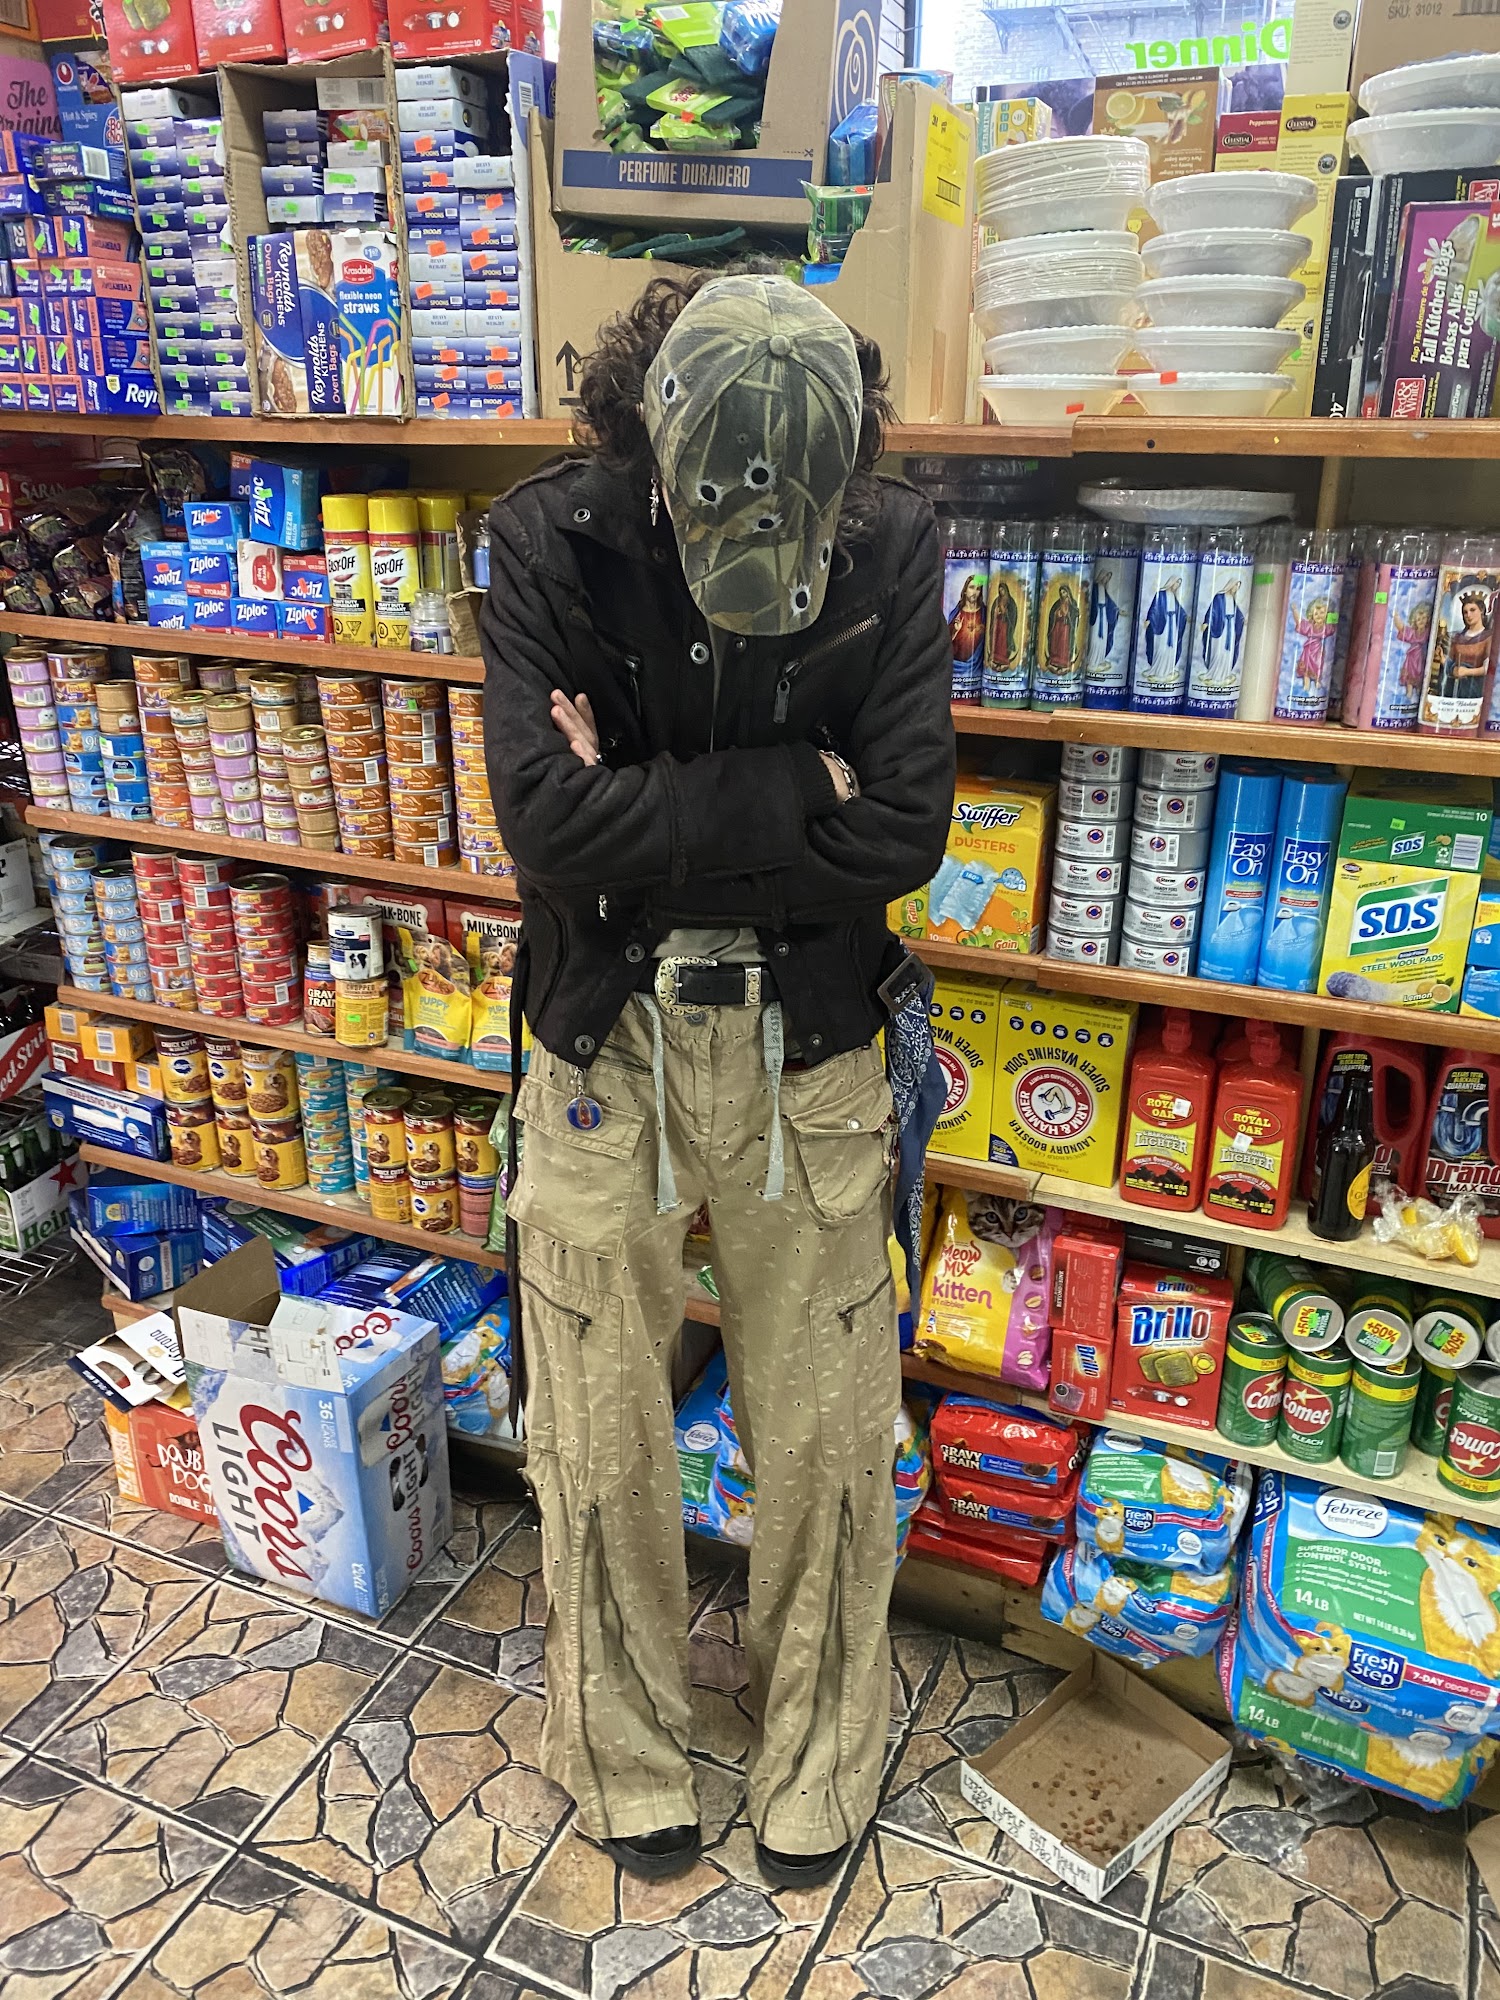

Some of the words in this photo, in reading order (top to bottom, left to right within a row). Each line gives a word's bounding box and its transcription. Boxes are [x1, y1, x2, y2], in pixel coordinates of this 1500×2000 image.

[474, 39, 481, 47] 10
[7, 80, 48, 110] The
[619, 159, 677, 185] PERFUME
[681, 162, 750, 188] DURADERO
[264, 243, 272, 274] Oven
[344, 263, 372, 275] Krasdale
[1433, 239, 1455, 277] Bags
[278, 241, 296, 313] Reynolds
[265, 277, 274, 304] Bags
[274, 271, 285, 325] KITCHENS
[340, 291, 363, 300] flexible
[1446, 283, 1465, 319] Altas
[343, 302, 380, 314] straws
[1426, 280, 1447, 335] Kitchen
[1461, 289, 1479, 335] Cocina
[317, 322, 329, 377] KITCHENS
[1411, 345, 1420, 362] Flap
[1421, 339, 1437, 364] Tall
[1441, 322, 1459, 366] Bolsas
[1457, 338, 1472, 368] para
[329, 344, 339, 370] Bags
[307, 335, 325, 404] Reynolds
[125, 384, 159, 407] Reyn
[330, 374, 340, 403] Oven
[292, 474, 299, 485] 28
[252, 476, 271, 528] Ziploc
[189, 557, 220, 574] Ziploc
[328, 556, 355, 573] EASY-OFF
[374, 558, 404, 576] EASY-OFF
[153, 569, 182, 585] Ziploc
[194, 601, 225, 618] Ziploc
[236, 604, 268, 620] Ziploc
[952, 803, 1019, 829] Swiffer
[1476, 812, 1487, 821] 10
[954, 836, 1016, 854] DUSTERS
[1229, 838, 1270, 862] Easy
[1232, 858, 1262, 876] On
[1284, 844, 1328, 871] Easy
[1286, 865, 1318, 885] On
[907, 901, 918, 924] Gain
[929, 933, 939, 941] 10
[994, 939, 1018, 950] Gain
[1361, 963, 1388, 973] STEEL
[1390, 959, 1418, 968] WOOL
[1419, 954, 1444, 963] PADS
[419, 996, 449, 1010] PUPPY
[1403, 992, 1433, 1002] Lemon
[957, 1036, 984, 1068] SUPER
[1028, 1046, 1078, 1068] WASHING
[1003, 1052, 1026, 1075] SODA
[1080, 1059, 1110, 1093] SUPER
[1020, 1090, 1059, 1136] HAMMER
[1146, 1097, 1175, 1112] ROYA
[1152, 1109, 1176, 1120] OAK
[1070, 1102, 1087, 1130] ARM
[1233, 1114, 1271, 1128] ROYAL
[1009, 1119, 1047, 1151] BOOSTER
[1060, 1124, 1070, 1136] &
[1238, 1124, 1263, 1136] OAK
[1050, 1135, 1096, 1154] LAUNDRY
[1135, 1132, 1188, 1155] LIGHTER
[1220, 1147, 1275, 1172] LIGHTER
[1449, 1184, 1478, 1194] MAX
[939, 1242, 982, 1262] Meow
[932, 1277, 993, 1309] kitten
[1156, 1281, 1195, 1293] Brillo
[1131, 1305, 1211, 1346] Brillo
[1366, 1320, 1396, 1342] +50%
[1443, 1331, 1465, 1357] +50%
[1077, 1344, 1099, 1378] Brillo
[319, 1400, 334, 1421] 36
[1283, 1393, 1331, 1425] Comet
[1456, 1405, 1488, 1424] BLEACH
[1291, 1433, 1324, 1446] BLEACH
[940, 1444, 983, 1462] GRAVY
[942, 1455, 982, 1471] TRAIN
[212, 1422, 261, 1543] LIGHT
[402, 1449, 418, 1510] LIGHT
[239, 1404, 313, 1582] Coors
[949, 1497, 990, 1515] GRAVY
[951, 1506, 989, 1521] TRAIN
[1125, 1510, 1153, 1520] Fresh
[1323, 1498, 1384, 1521] febreze
[1126, 1519, 1150, 1529] Step
[1327, 1515, 1376, 1530] freshness
[406, 1506, 424, 1571] Coors
[1296, 1551, 1346, 1565] CONTROL
[1297, 1545, 1349, 1558] SUPERIOR
[1350, 1551, 1382, 1568] ODOR
[1294, 1588, 1314, 1606] 14
[1314, 1598, 1330, 1612] LB
[1353, 1647, 1400, 1674] Fresh
[1351, 1667, 1394, 1687] Step
[1412, 1671, 1444, 1687] 7-DAY
[1247, 1705, 1266, 1722] 14
[1265, 1714, 1280, 1729] LB
